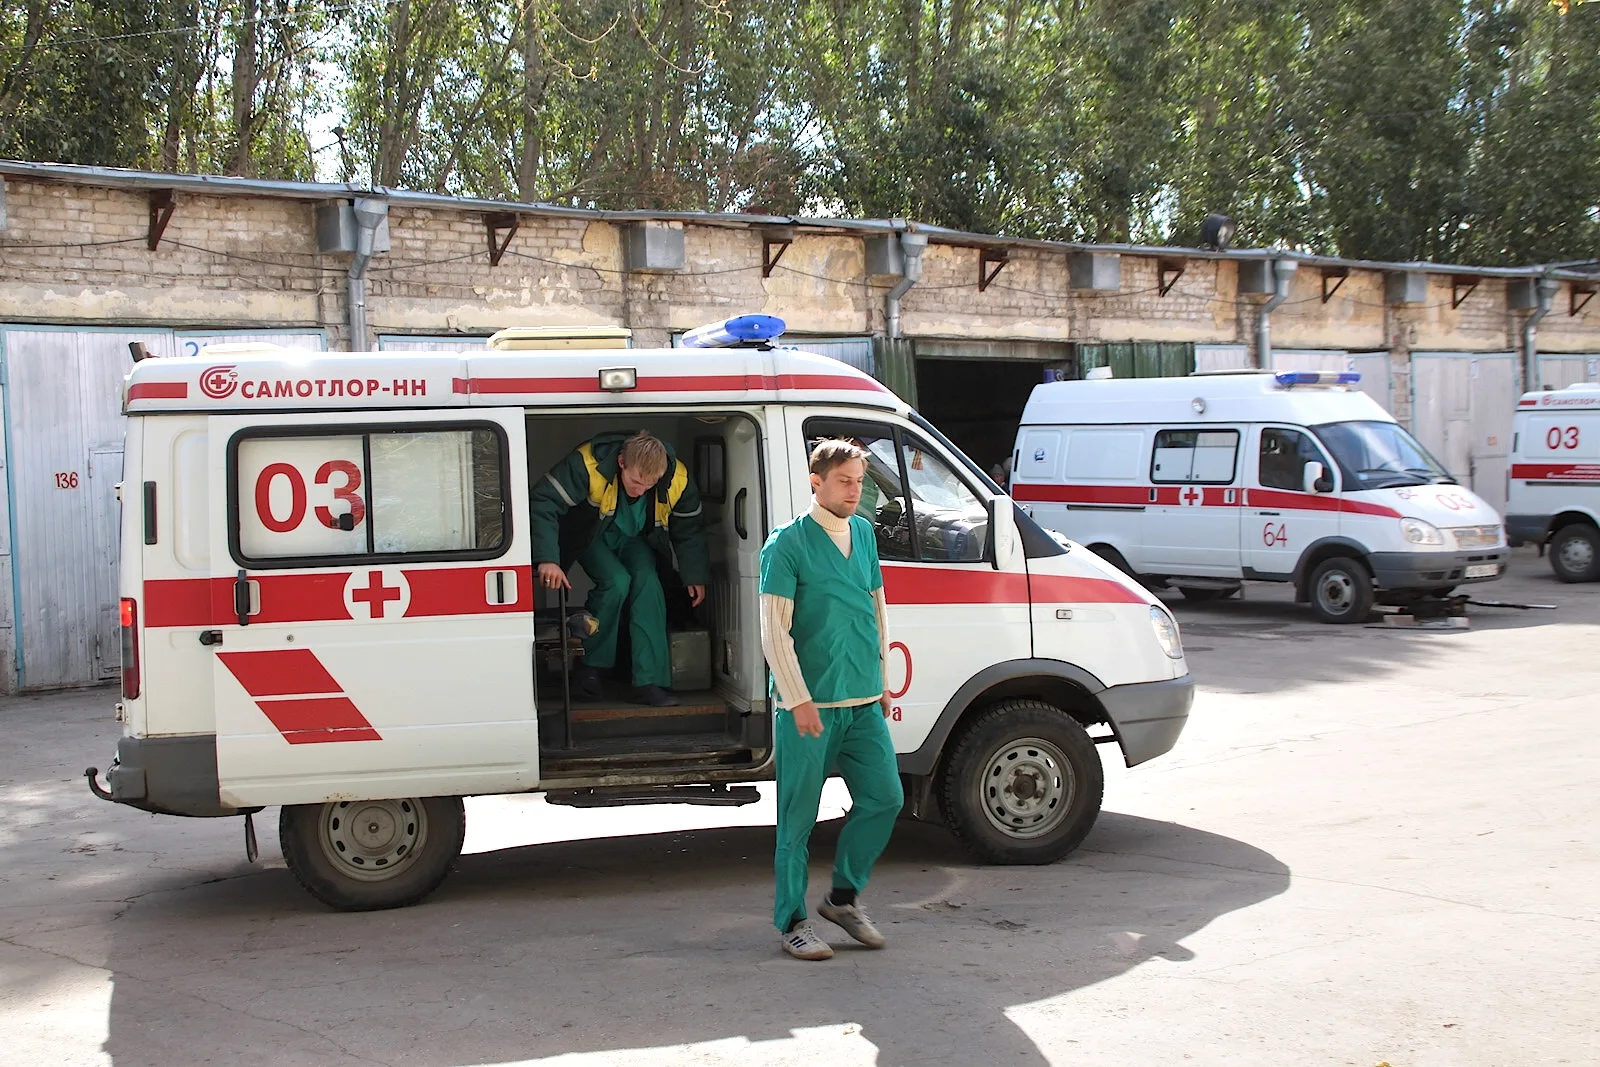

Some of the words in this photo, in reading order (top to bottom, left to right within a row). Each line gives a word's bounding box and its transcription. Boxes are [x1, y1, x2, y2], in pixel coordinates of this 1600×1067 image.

[241, 379, 426, 399] САМОТЛОР-НН
[1546, 426, 1579, 450] 03
[55, 471, 79, 489] 136
[255, 460, 366, 533] 03
[1263, 522, 1288, 547] 64
